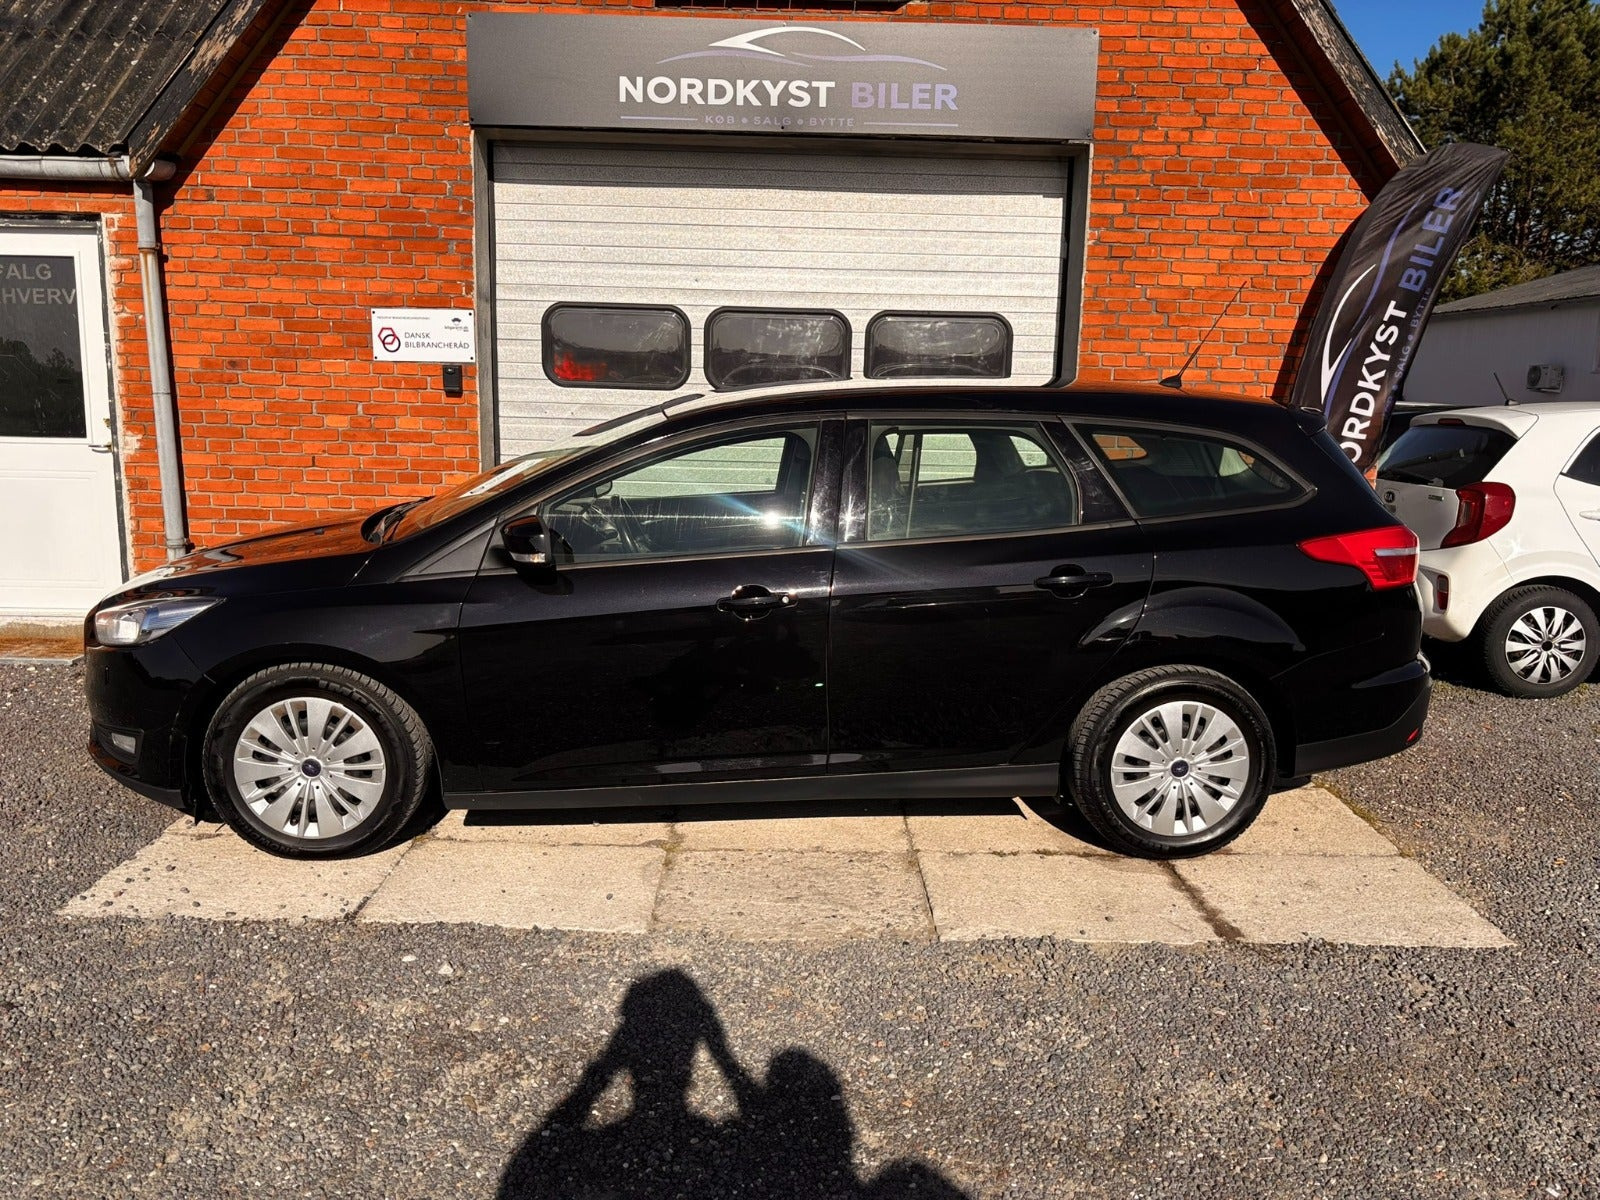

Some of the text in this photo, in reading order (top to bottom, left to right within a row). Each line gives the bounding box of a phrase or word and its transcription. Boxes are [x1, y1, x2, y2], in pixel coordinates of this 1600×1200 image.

[618, 75, 959, 111] NORDKYST BILER
[705, 115, 855, 127] KØB SALG BYTTE
[0, 263, 52, 280] ALG
[0, 287, 76, 305] HVERV
[1339, 187, 1464, 464] ORDKYST BILER
[404, 341, 470, 349] BILBRANCHERÅD
[1394, 345, 1412, 379] SALG
